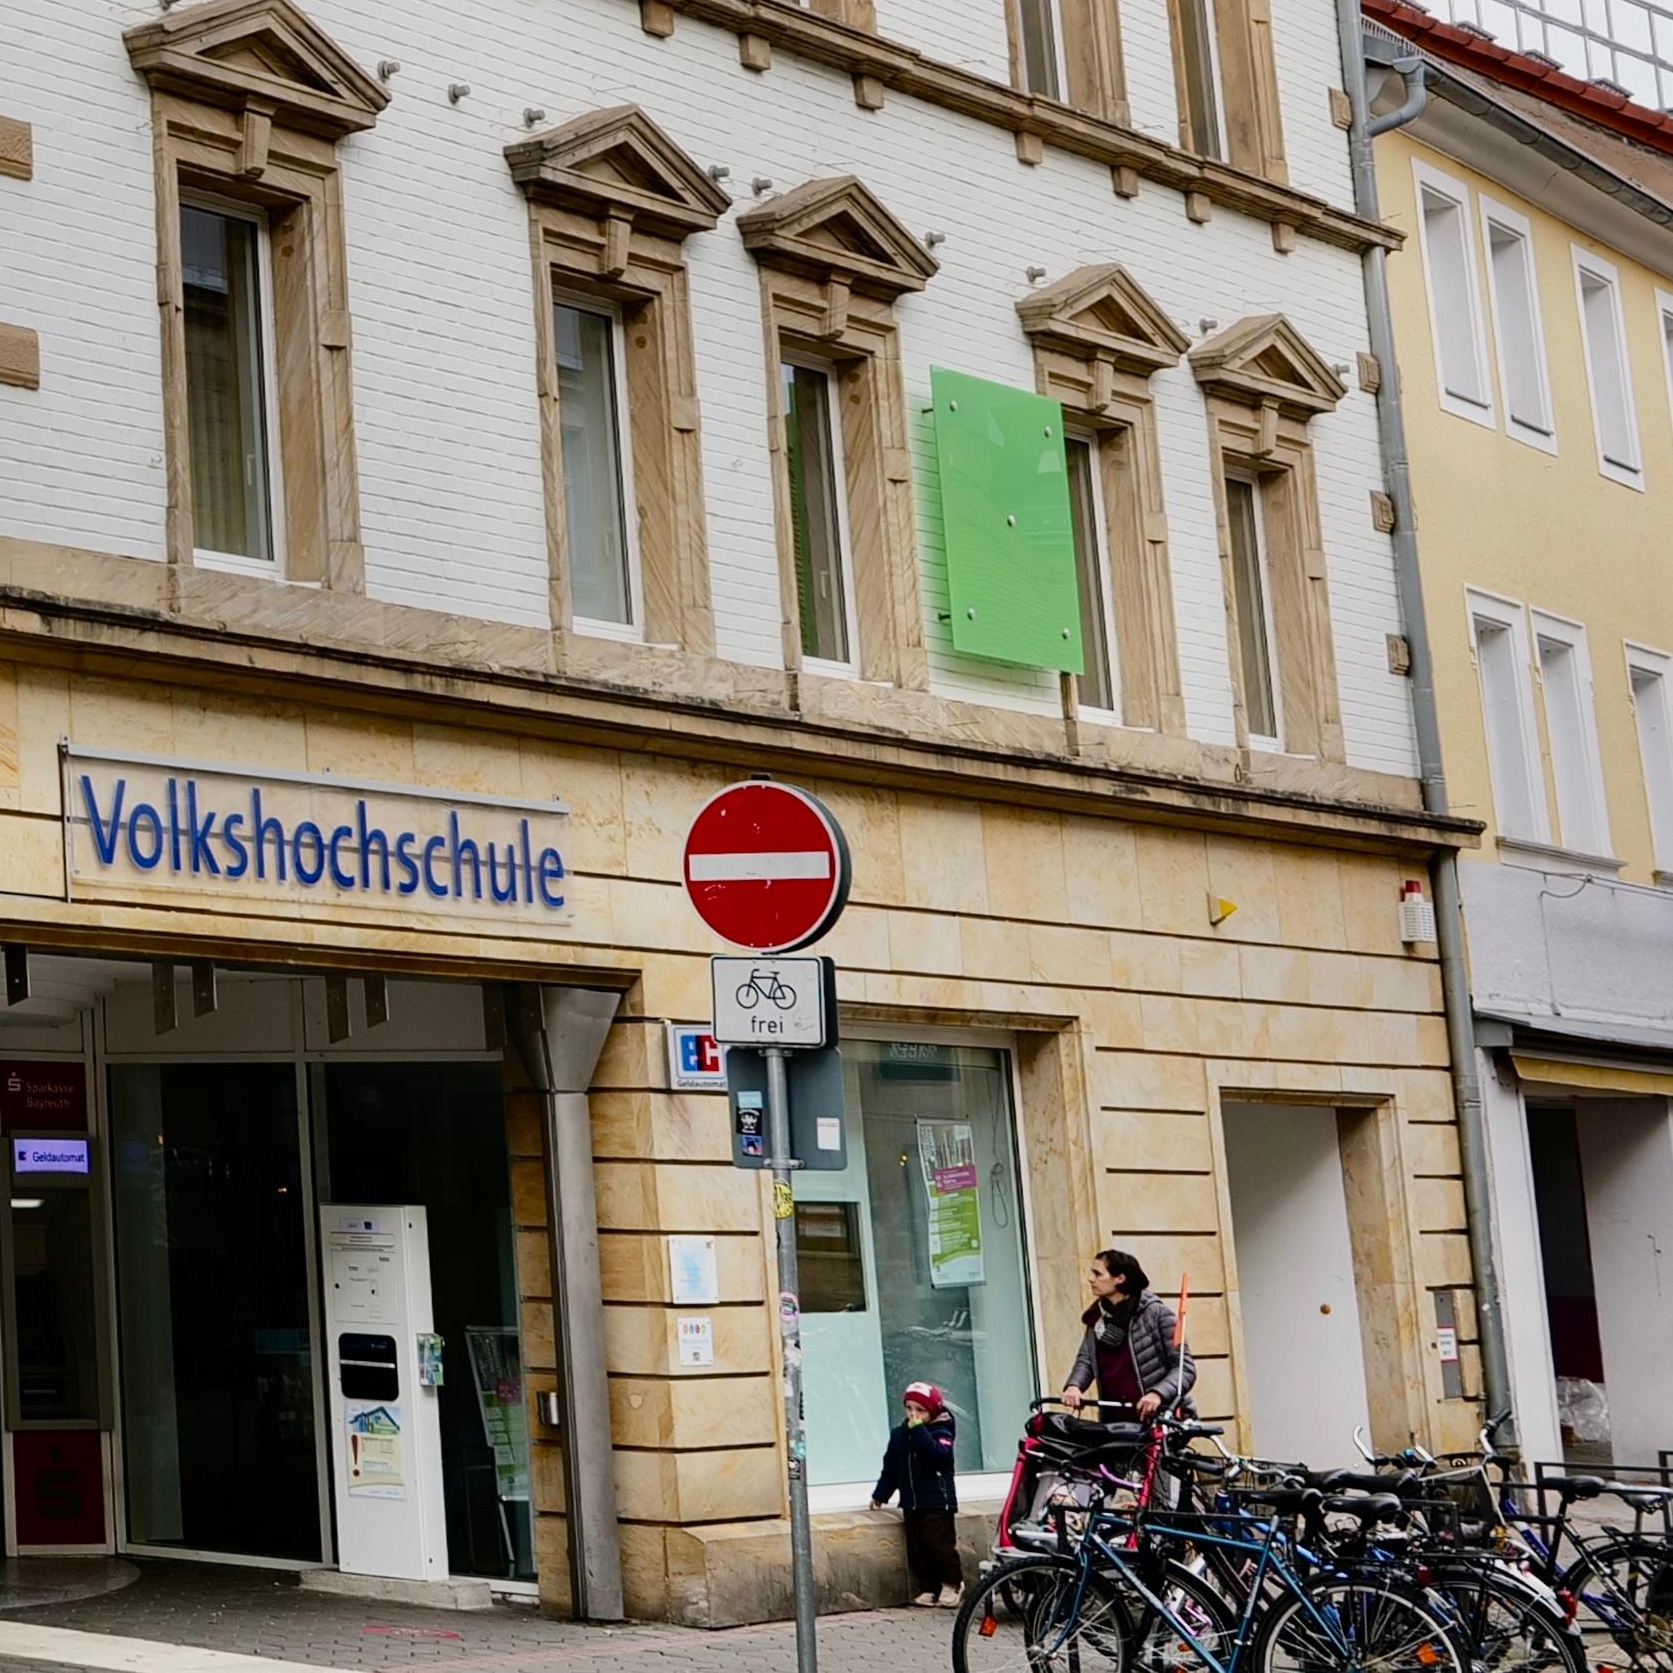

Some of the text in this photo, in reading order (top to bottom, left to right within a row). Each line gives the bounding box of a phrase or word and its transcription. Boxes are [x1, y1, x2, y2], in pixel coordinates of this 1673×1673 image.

[79, 774, 566, 909] Volkshochschule
[751, 1015, 784, 1033] frei
[26, 1080, 75, 1093] Sparkasse
[27, 1097, 70, 1110] Bayreuth
[32, 1151, 85, 1163] Geldautomat
